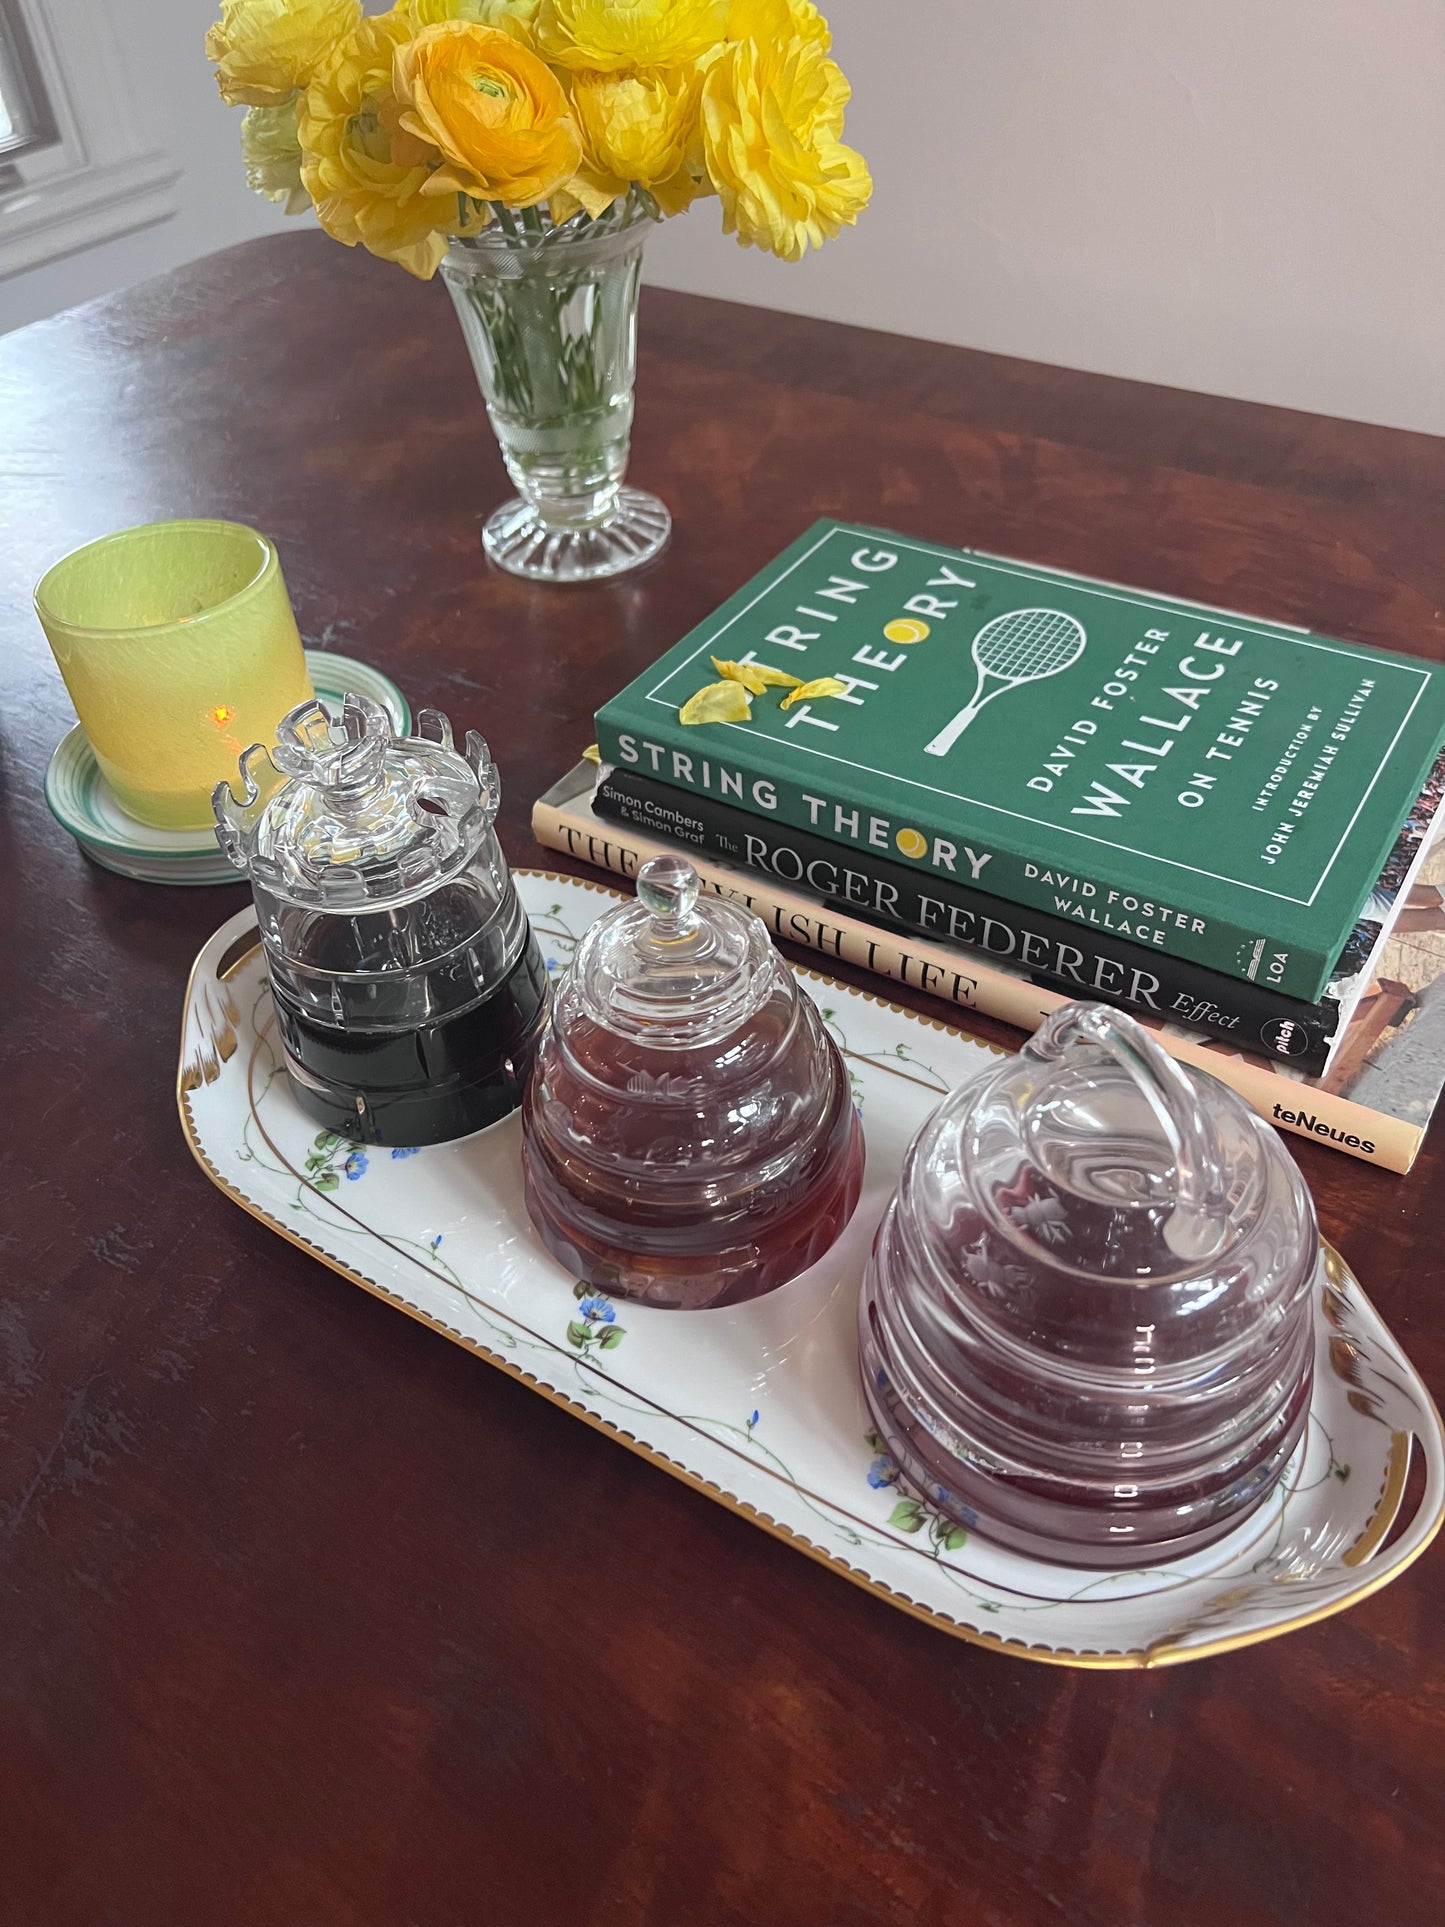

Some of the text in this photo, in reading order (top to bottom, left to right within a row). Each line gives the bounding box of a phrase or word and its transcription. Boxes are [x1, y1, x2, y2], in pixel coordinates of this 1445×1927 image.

[737, 548, 898, 705] TRING
[785, 566, 976, 731] THEORY
[1026, 627, 1171, 792] DAVID FOSTER
[1070, 632, 1244, 818] WALLACE
[1177, 677, 1279, 808] ON TENNIS
[1252, 705, 1322, 812] INTRODUCTION BY
[602, 785, 704, 832] Simon Cambers
[618, 734, 993, 879] STRING THEORY
[1260, 678, 1377, 865] JOHN JEREMIAH SULLIVAN
[620, 806, 705, 845] & Simon Graf
[715, 833, 1241, 1029] The ROGER FEDERER Effect
[1024, 863, 1207, 935] DAVID FOSTER
[1054, 896, 1166, 945] WALLACE
[865, 939, 979, 1009] LIFE
[1266, 952, 1289, 983] LOA
[1274, 1020, 1296, 1055] pitch
[1272, 1103, 1377, 1155] teNeues
